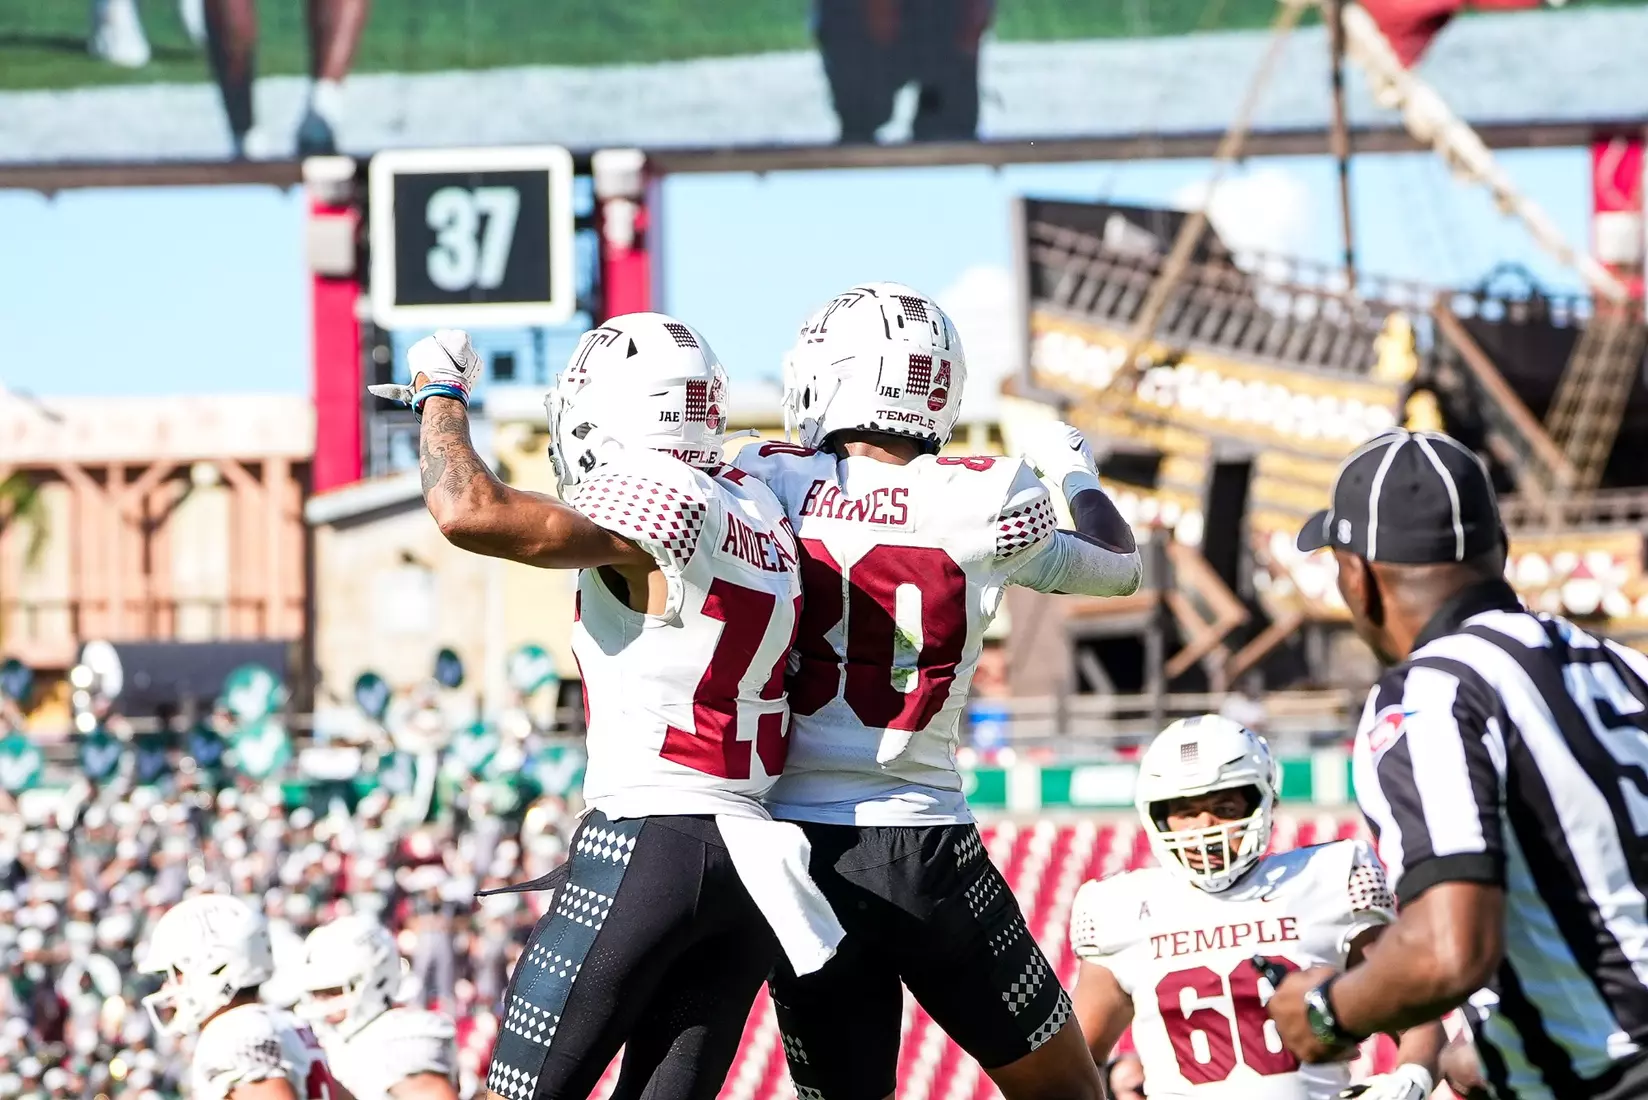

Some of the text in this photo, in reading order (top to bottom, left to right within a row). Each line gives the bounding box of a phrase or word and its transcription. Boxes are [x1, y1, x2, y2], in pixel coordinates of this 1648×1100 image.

[425, 185, 521, 292] 37
[879, 385, 901, 399] JAE
[659, 410, 681, 423] JAE
[876, 409, 936, 431] TEMPLE
[649, 447, 718, 465] MPLE
[1150, 916, 1301, 960] TEMPLE
